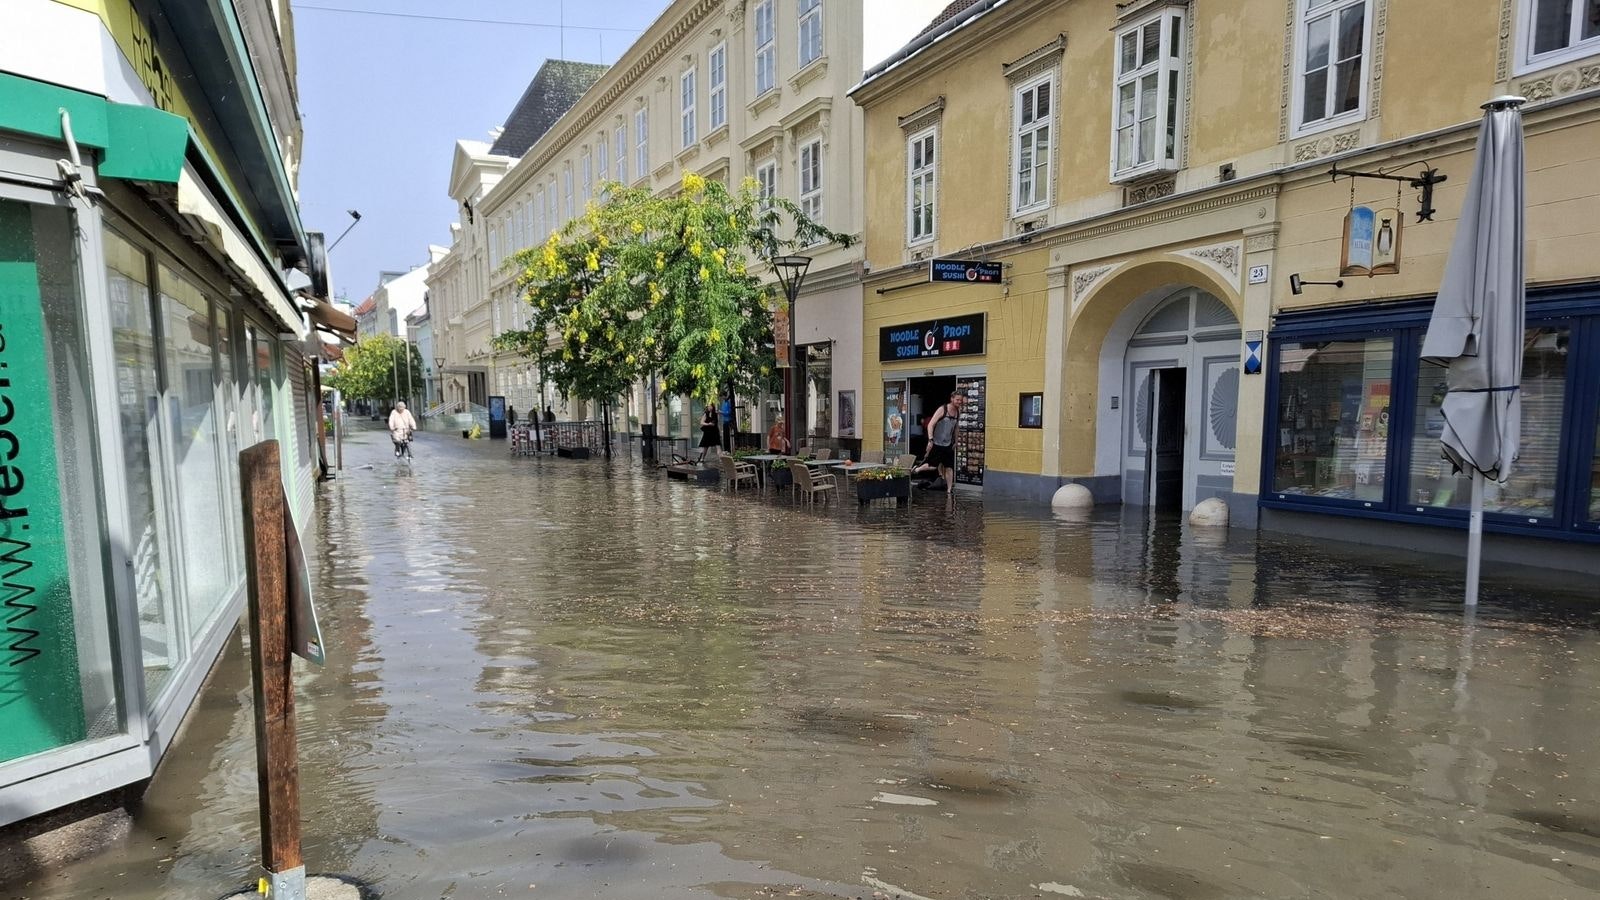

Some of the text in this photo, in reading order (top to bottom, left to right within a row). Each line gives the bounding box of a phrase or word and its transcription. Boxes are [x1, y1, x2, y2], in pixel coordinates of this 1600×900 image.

[935, 263, 966, 271] NOODLE
[1253, 267, 1264, 278] 23
[890, 329, 919, 343] NOODLE
[943, 325, 971, 338] PROFI
[896, 345, 919, 357] SUSHI
